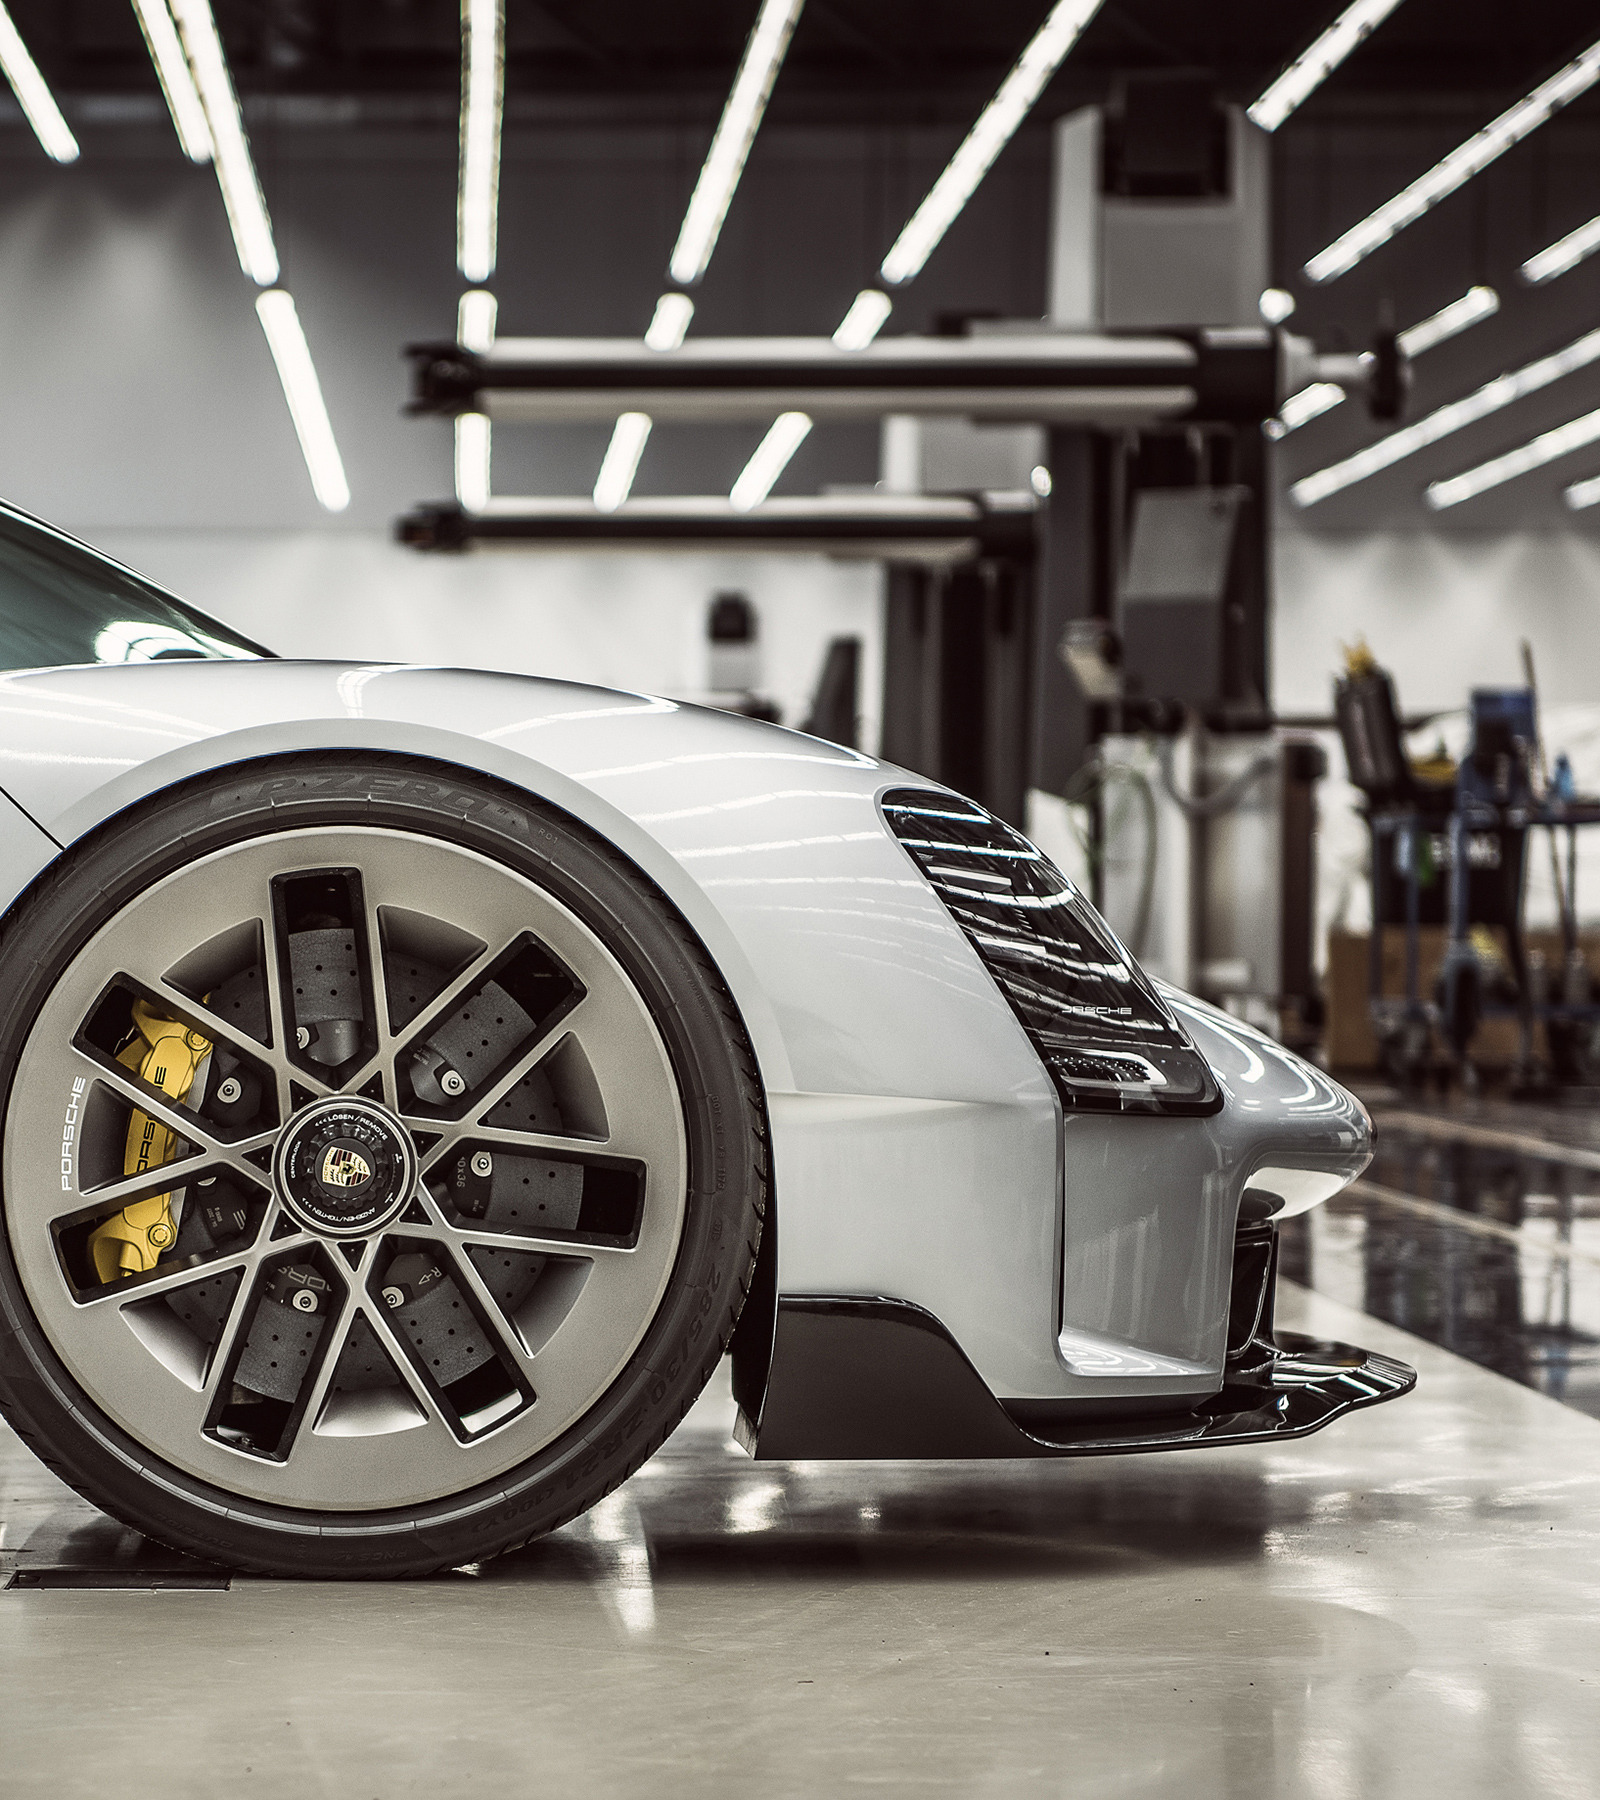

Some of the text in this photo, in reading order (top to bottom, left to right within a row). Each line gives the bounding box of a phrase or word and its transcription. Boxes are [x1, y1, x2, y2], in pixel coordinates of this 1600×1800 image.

[256, 777, 298, 799] P
[308, 774, 490, 815] ZERO
[327, 1113, 354, 1122] LÖSEN
[359, 1117, 389, 1141] REMOVE
[709, 1093, 722, 1115] DOT
[61, 1076, 86, 1191] PORSCHE
[649, 1263, 722, 1405] 285/30
[563, 1414, 646, 1486] ZR21
